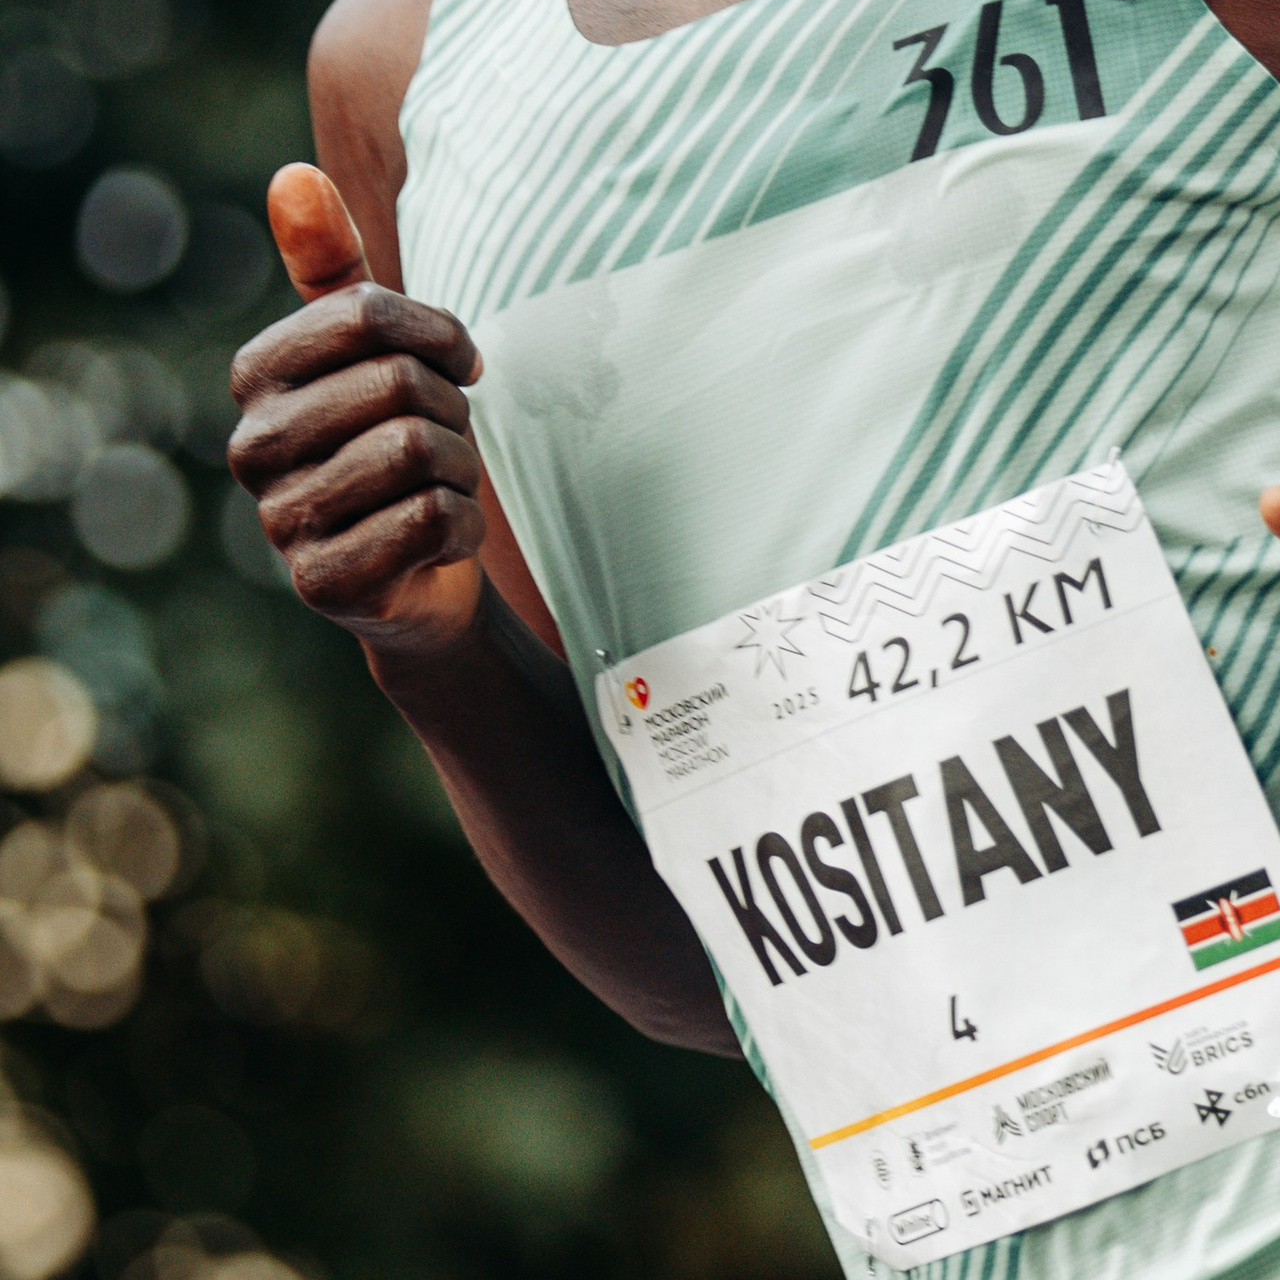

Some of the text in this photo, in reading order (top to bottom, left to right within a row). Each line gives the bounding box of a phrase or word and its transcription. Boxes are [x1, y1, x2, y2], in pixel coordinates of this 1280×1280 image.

[847, 611, 981, 703] 42,2
[643, 682, 730, 730] МОСКОВСКИЙ
[771, 686, 820, 720] 2025
[706, 687, 1163, 987] KOSITANY
[949, 994, 978, 1042] 4
[1190, 1030, 1255, 1067] BRICS
[1014, 1057, 1114, 1113] МОСКОВСКИЙ
[1024, 1100, 1069, 1133] СПОРТ
[1116, 1122, 1167, 1154] ПСБ
[979, 1165, 1052, 1208] МАГНИТ
